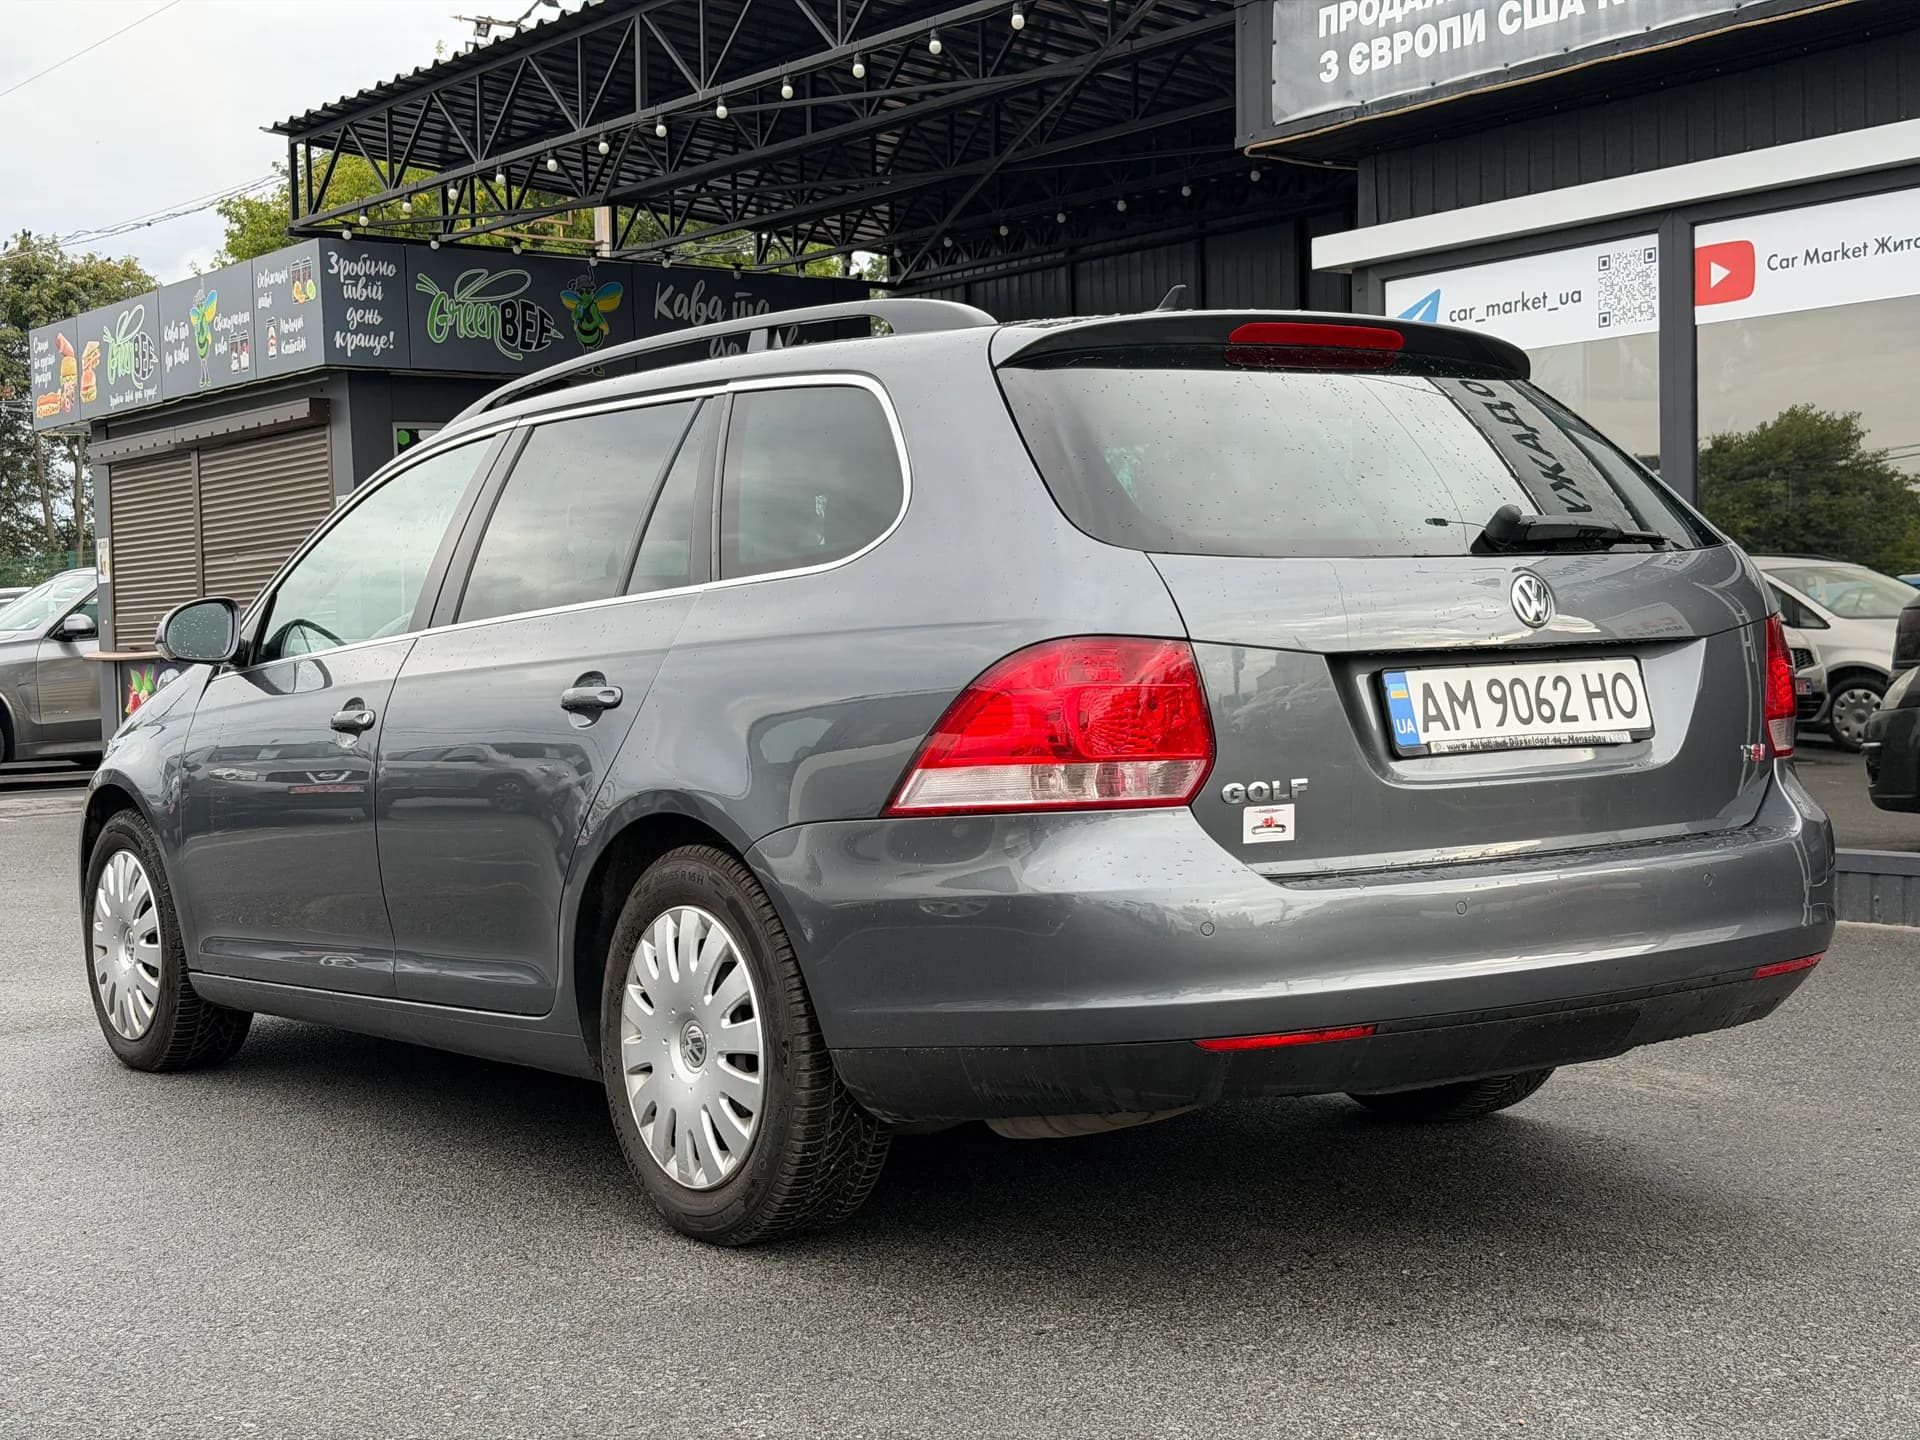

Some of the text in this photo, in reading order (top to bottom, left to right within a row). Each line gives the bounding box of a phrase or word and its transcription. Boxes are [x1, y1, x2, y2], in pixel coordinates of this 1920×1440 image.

[1348, 8, 1486, 76] ЄВРОПИ
[1497, 0, 1586, 35] США
[327, 251, 397, 283] Зробимо
[1766, 252, 1798, 272] Car
[1803, 241, 1868, 267] Market
[343, 276, 384, 301] твій
[654, 279, 726, 326] Кава
[346, 306, 384, 330] день
[1447, 286, 1583, 323] car_market_ua
[334, 330, 395, 358] краще!
[1422, 672, 1638, 733] AM 9062 HO
[1397, 718, 1417, 735] UA
[1221, 778, 1309, 804] GOLF
